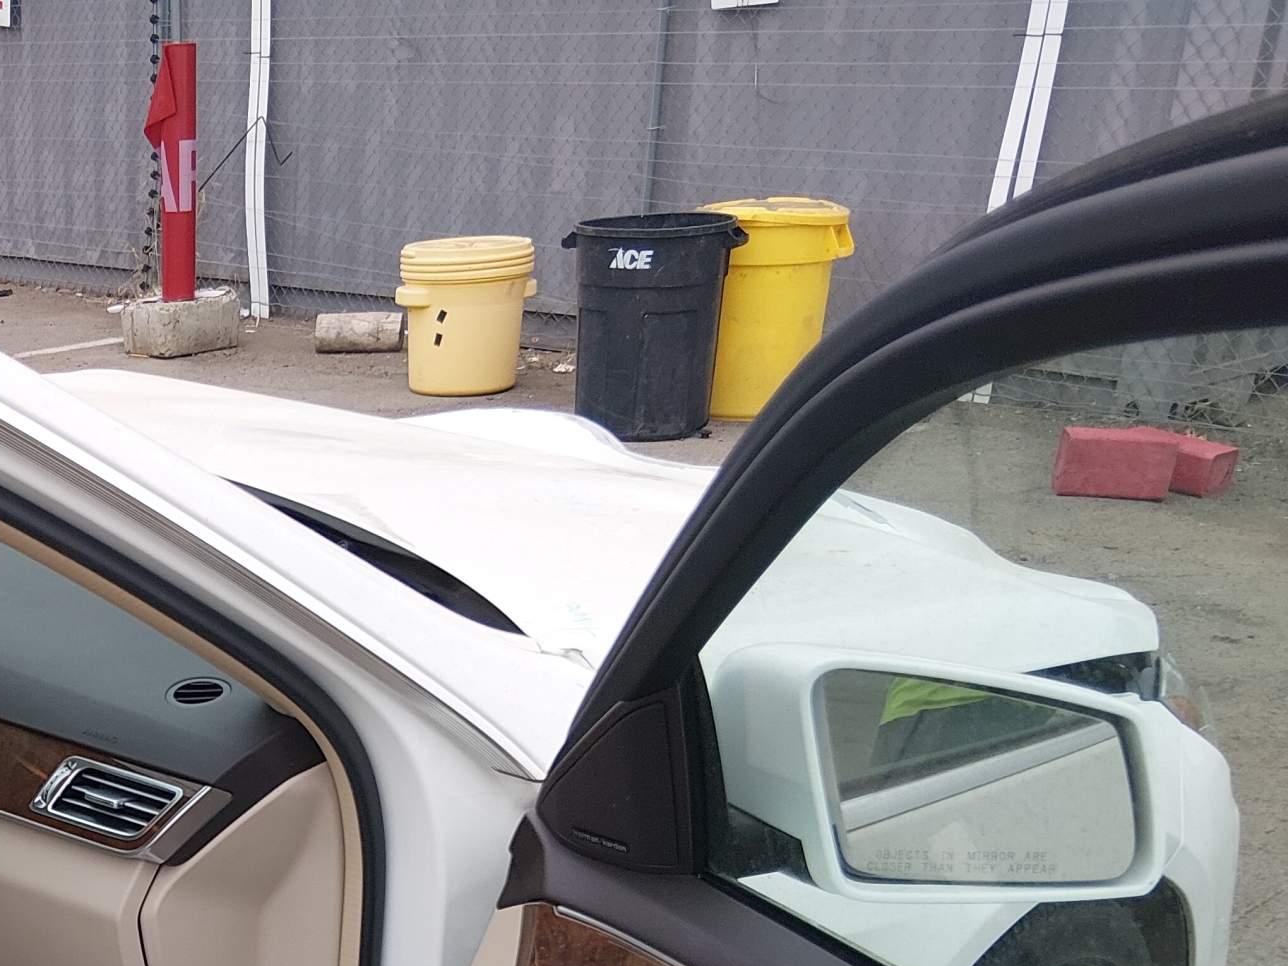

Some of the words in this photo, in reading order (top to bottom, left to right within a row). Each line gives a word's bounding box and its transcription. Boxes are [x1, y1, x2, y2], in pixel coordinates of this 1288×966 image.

[608, 247, 654, 270] ACE
[875, 849, 929, 860] OBJECTS
[967, 851, 1016, 861] MIRROR
[1024, 851, 1049, 861] ARE
[866, 862, 912, 872] CLOSER
[923, 862, 953, 873] THAN
[967, 863, 995, 873] THEY
[1008, 864, 1056, 874] APPEAR
